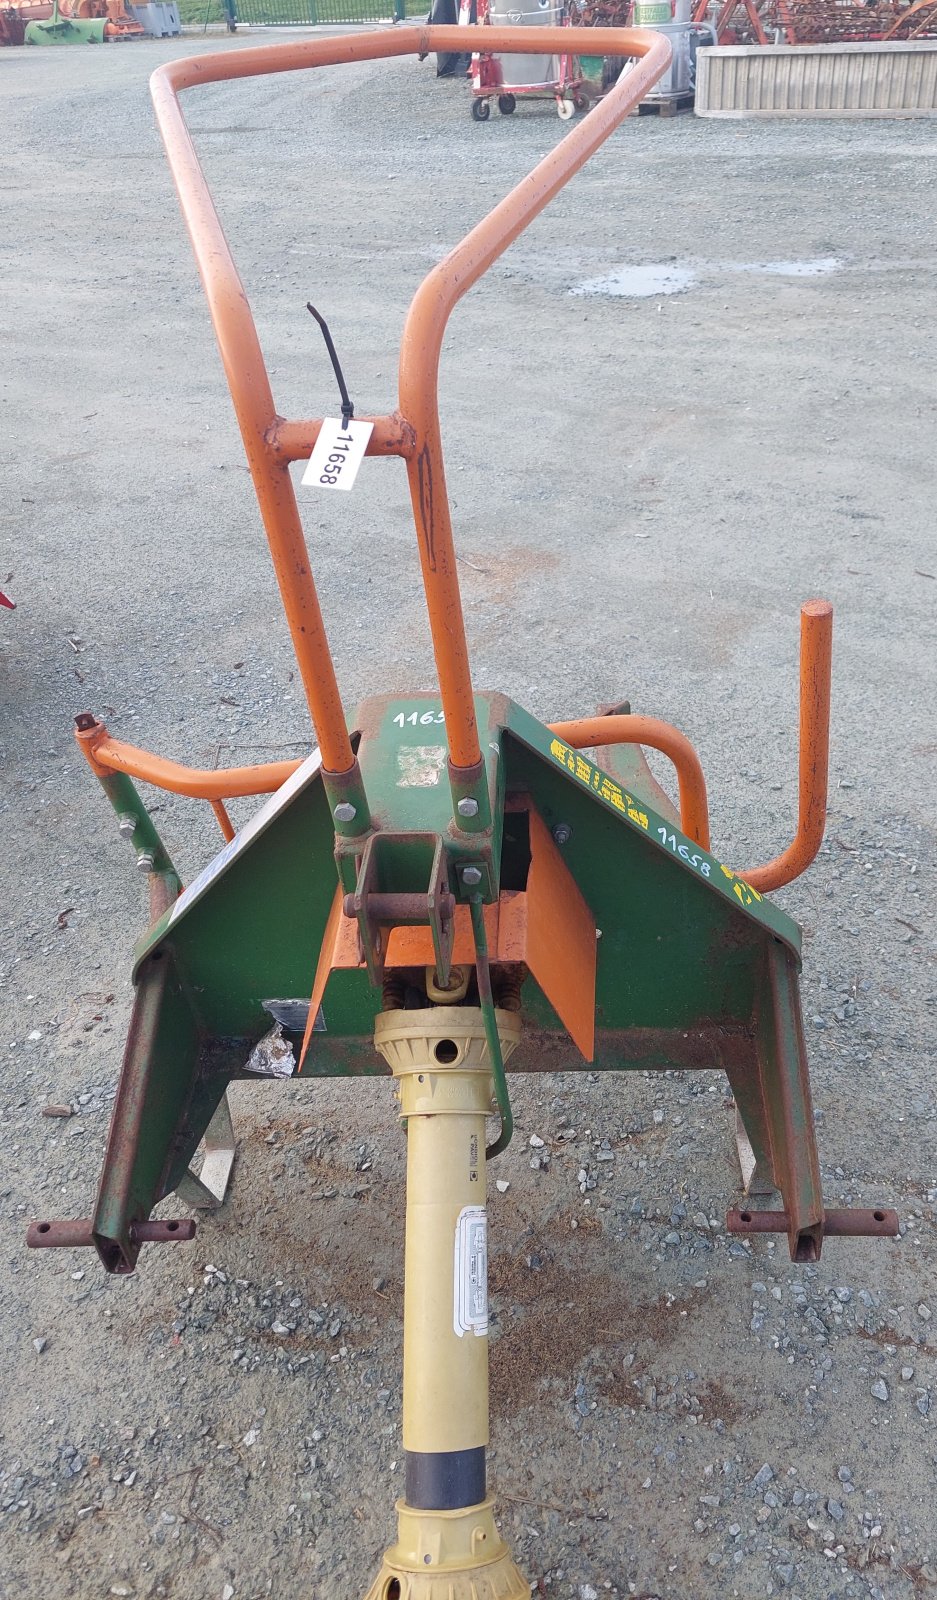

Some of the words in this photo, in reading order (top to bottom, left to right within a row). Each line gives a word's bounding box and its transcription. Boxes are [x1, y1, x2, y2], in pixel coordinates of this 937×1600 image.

[319, 434, 354, 485] 11658
[392, 710, 446, 728] 1165
[657, 826, 711, 878] 11658
